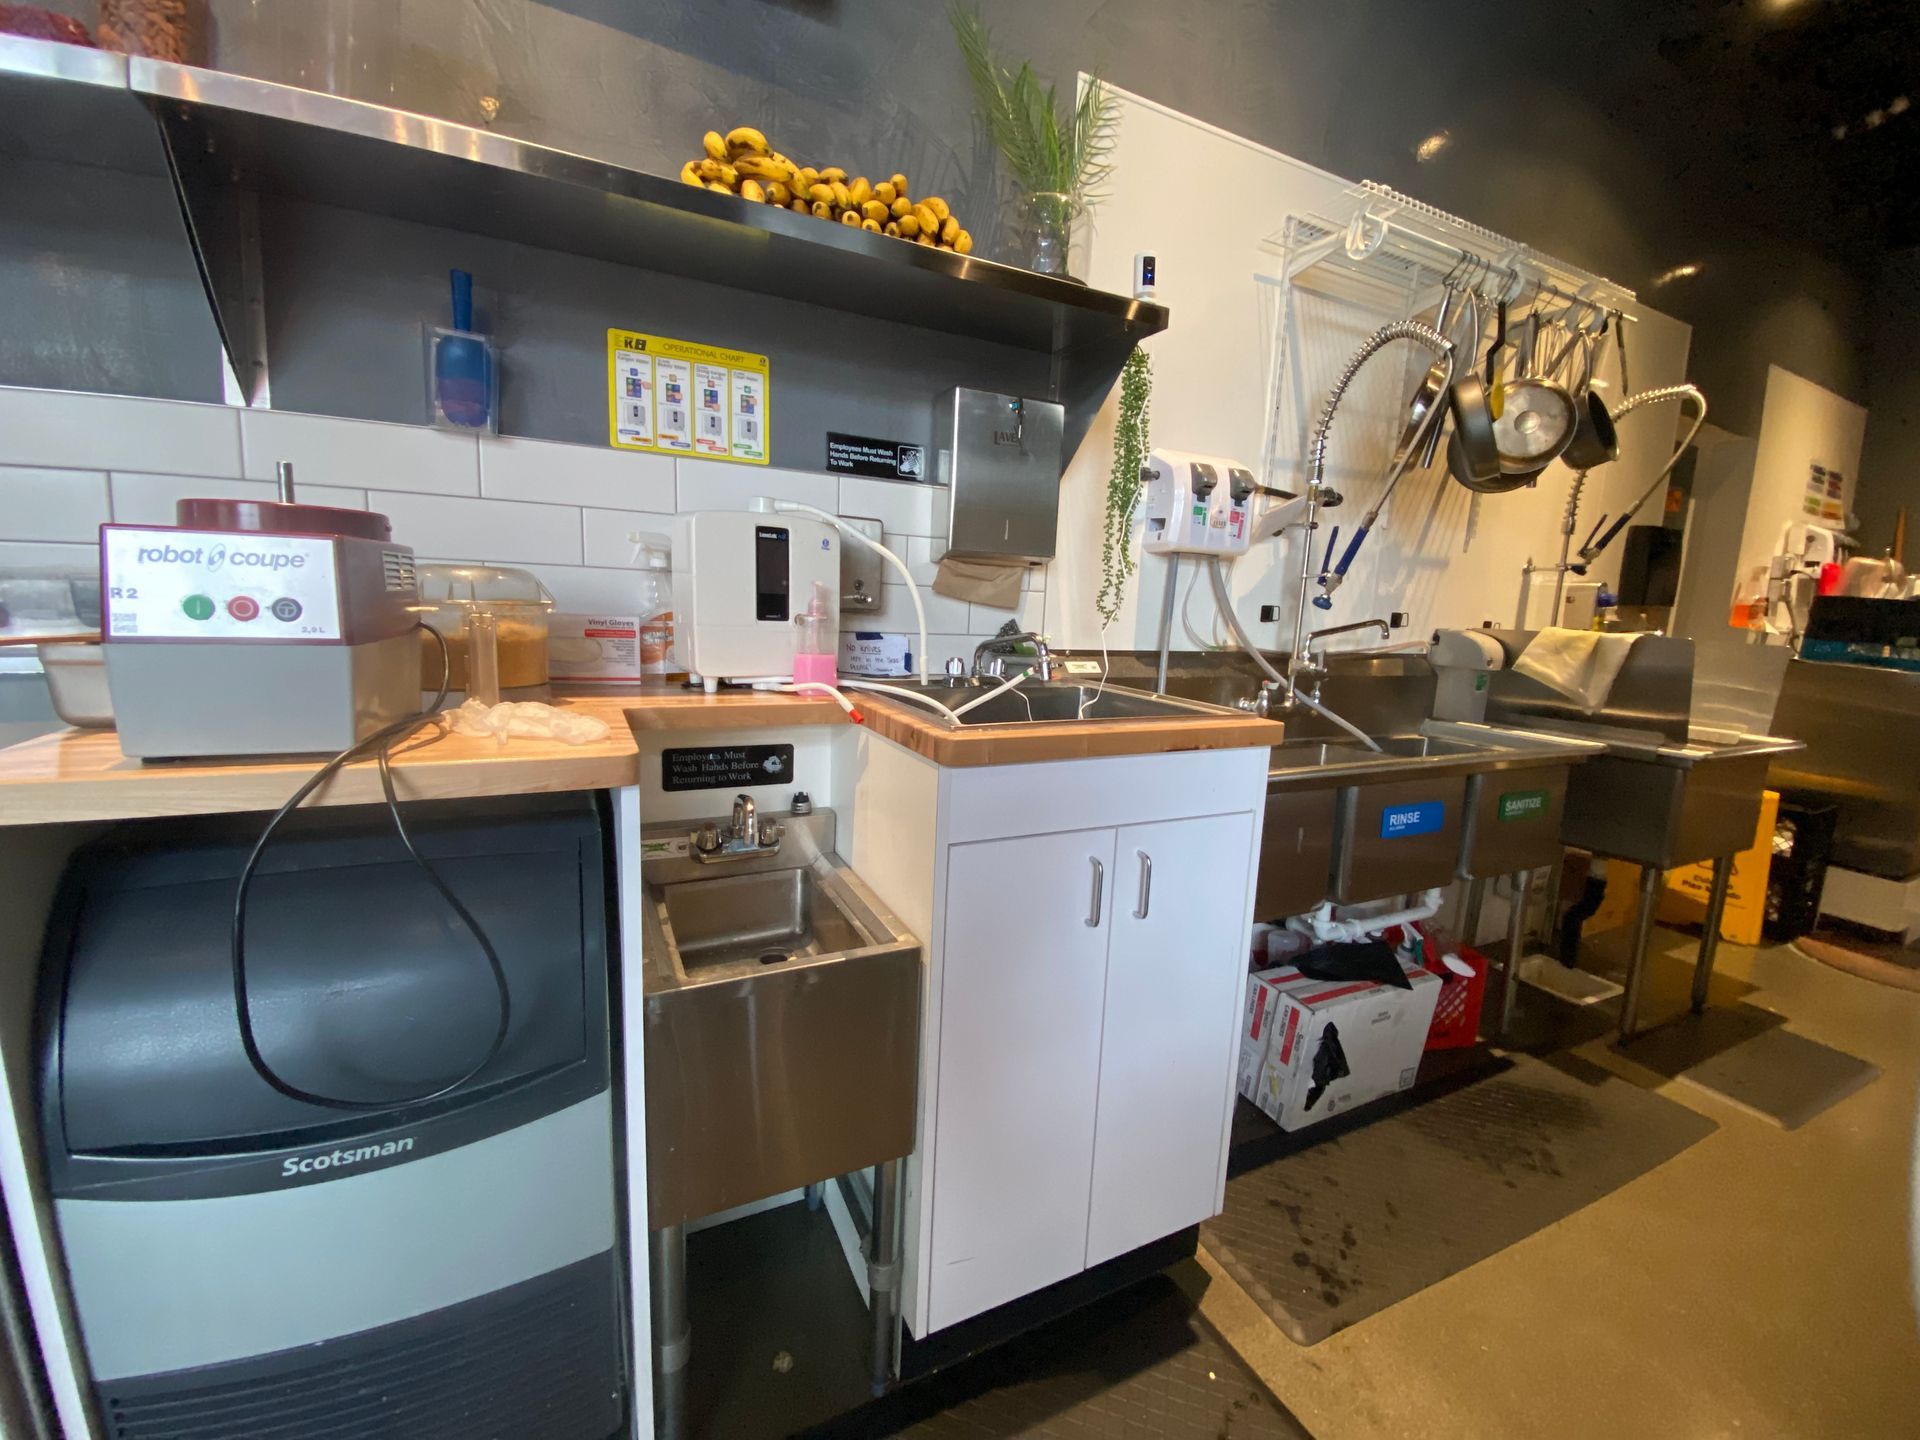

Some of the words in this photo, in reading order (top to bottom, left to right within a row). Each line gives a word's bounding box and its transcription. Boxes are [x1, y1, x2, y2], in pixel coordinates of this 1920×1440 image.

[663, 343, 718, 360] OPERATIONAL
[720, 352, 745, 363] CHART
[829, 442, 861, 452] Employees
[862, 446, 877, 454] Must
[829, 450, 849, 459] Hands
[849, 452, 868, 461] Before
[869, 456, 897, 466] Returning
[137, 544, 204, 565] robot
[229, 551, 306, 571] coupe
[110, 587, 124, 599] R
[126, 587, 139, 599] 2
[588, 619, 607, 627] Vinyl
[609, 619, 634, 627] Gloves
[846, 643, 856, 652] No
[672, 752, 721, 764] Employees
[723, 750, 746, 760] Must
[672, 764, 698, 773] Wash
[701, 763, 729, 772] Hands
[731, 760, 760, 770] Before
[671, 774, 717, 785] Returning
[718, 774, 728, 782] to
[728, 771, 753, 781] Work
[1505, 797, 1542, 812] SANITIZE
[1389, 811, 1421, 826] RINSE
[281, 1136, 414, 1177] Scotsman
